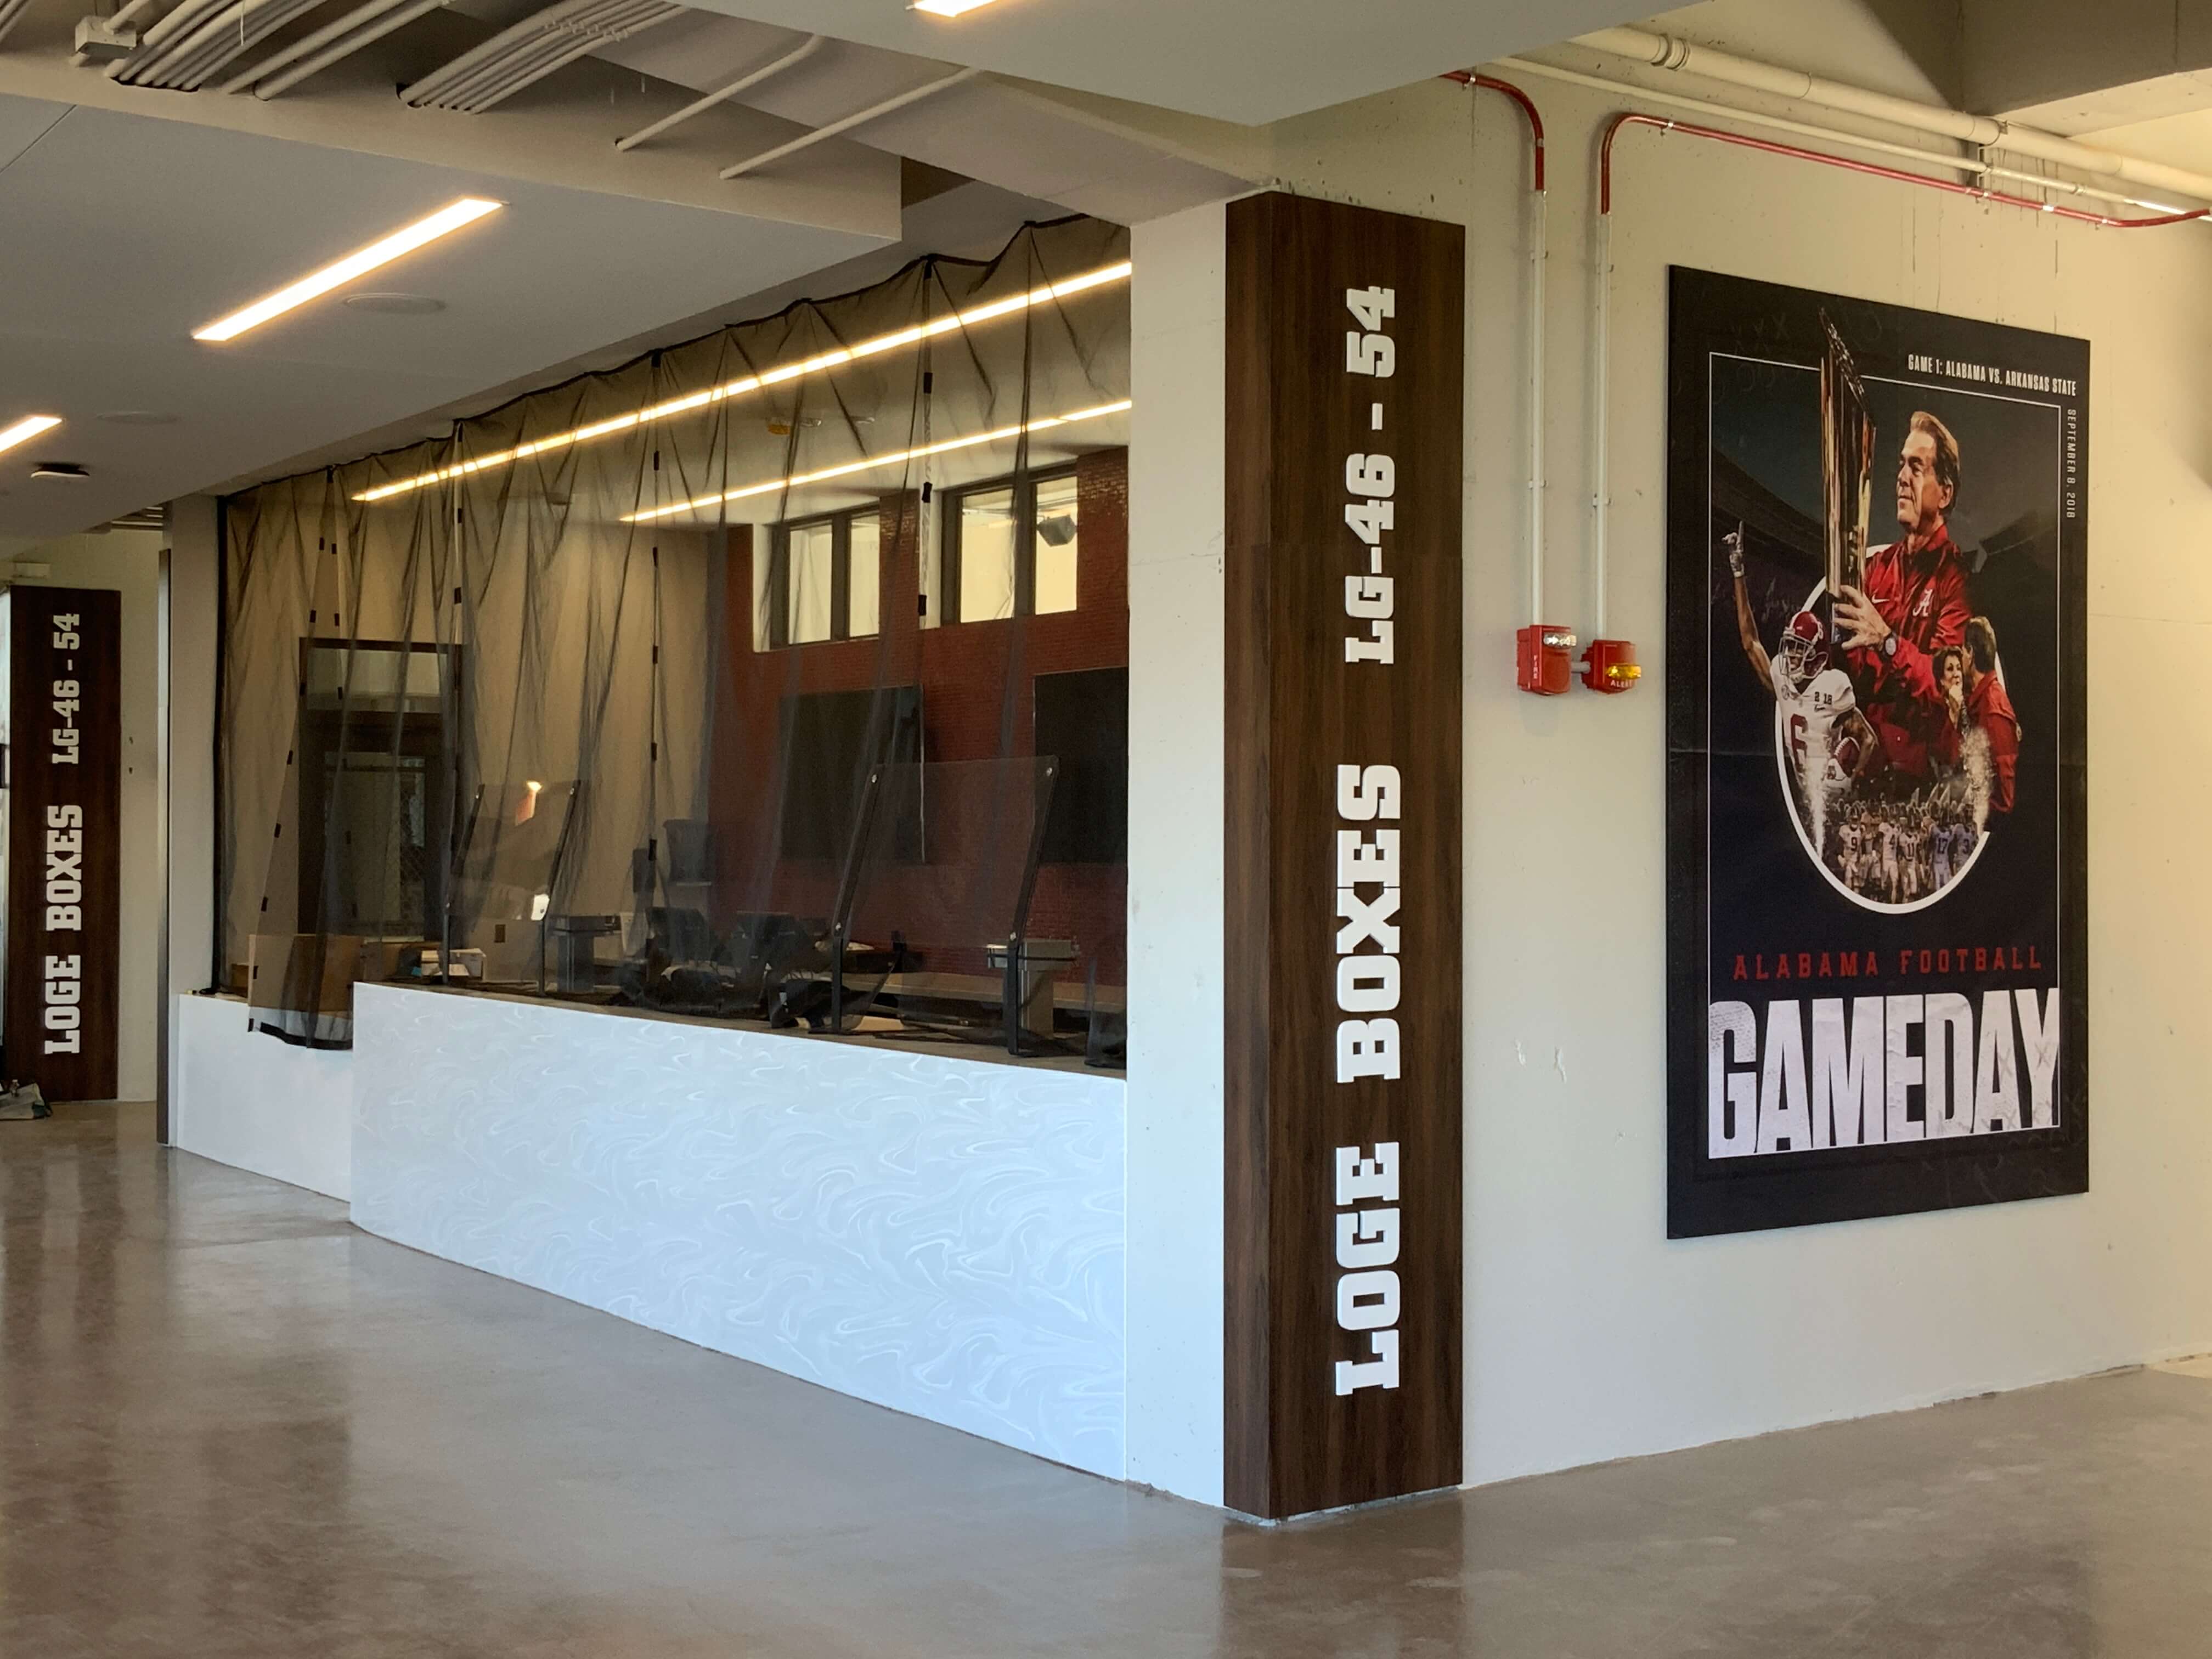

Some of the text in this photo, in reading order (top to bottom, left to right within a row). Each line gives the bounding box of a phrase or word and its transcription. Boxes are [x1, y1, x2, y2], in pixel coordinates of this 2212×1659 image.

[1346, 286, 1395, 377] 54
[1908, 354, 2076, 396] GAME 1: ALABAMA VS. ARKANSAS STATE
[2067, 409, 2076, 473] SEPTEMBER
[2066, 492, 2076, 518] 2018
[1345, 454, 1395, 664] LG-46
[53, 613, 80, 650] 54
[52, 680, 80, 764] LG-46
[46, 805, 83, 931] BOXES
[1336, 764, 1401, 1084] BOXES
[1733, 946, 2042, 980] ALABAMA FOOTBALL
[44, 955, 81, 1054] LOGE
[1708, 987, 2061, 1159] GAMEDAY
[1335, 1142, 1401, 1396] LOGE
